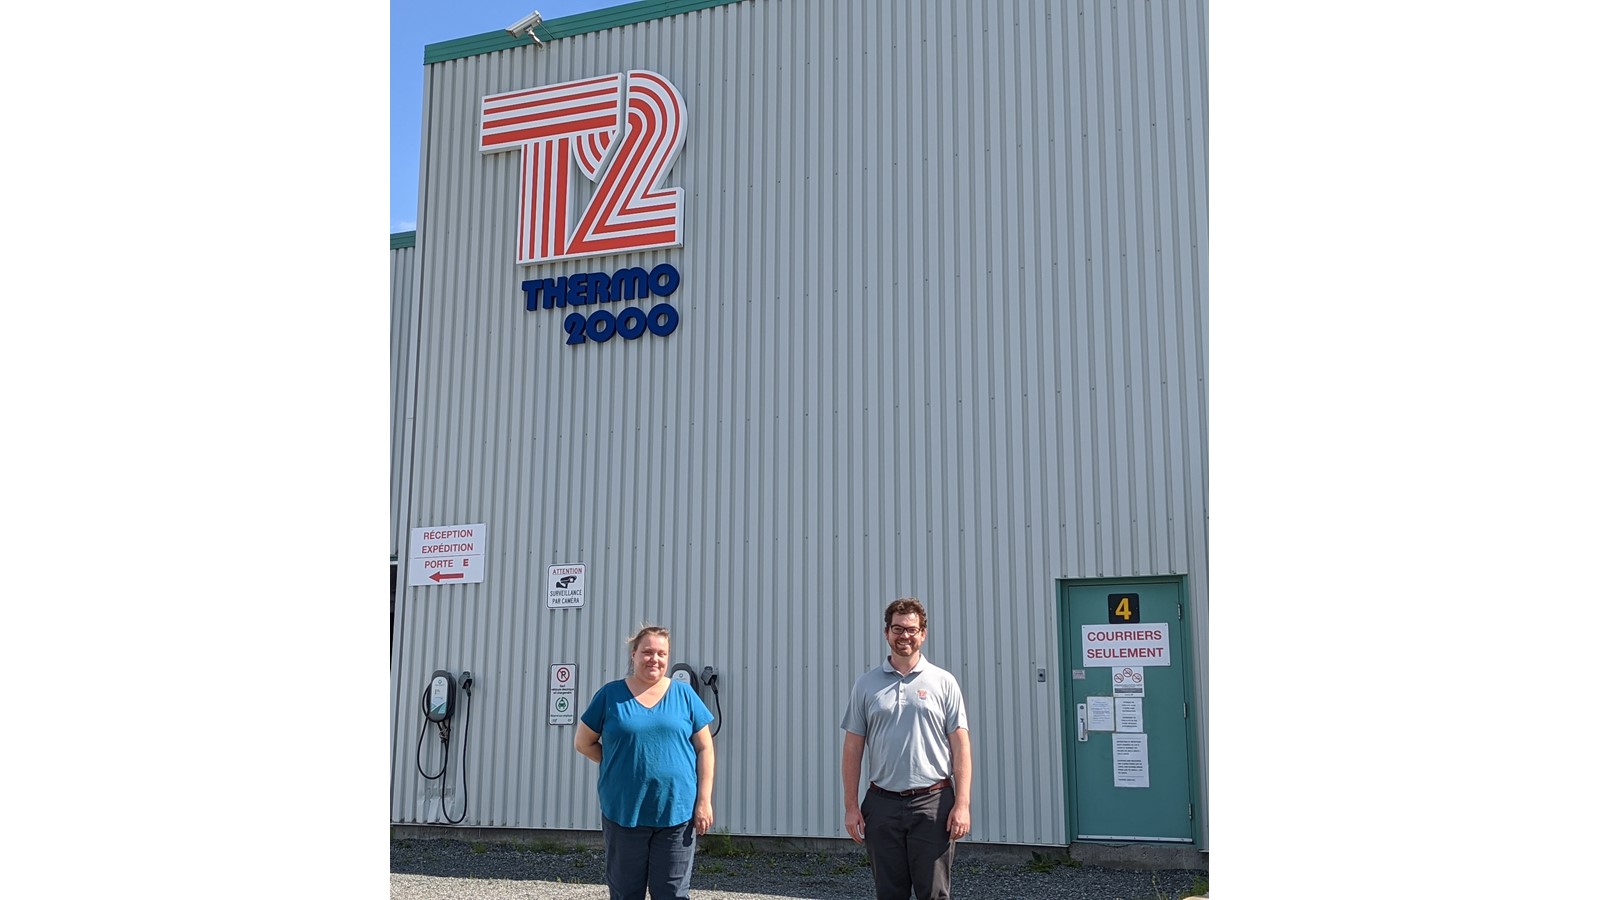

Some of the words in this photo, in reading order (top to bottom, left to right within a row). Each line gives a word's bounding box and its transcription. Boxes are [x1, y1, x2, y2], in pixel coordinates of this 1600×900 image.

[522, 263, 680, 311] THERMO
[564, 303, 680, 345] 2000
[423, 529, 473, 541] RÉCEPTION
[421, 543, 474, 554] EXPÉDITION
[424, 559, 454, 569] PORTE
[463, 558, 469, 567] E
[552, 567, 583, 575] ATTENTION
[550, 589, 582, 597] SURVEILLANCE
[561, 596, 580, 604] CAMÉRA
[1115, 597, 1132, 621] 4
[1087, 630, 1162, 642] COURRIERS
[1087, 647, 1164, 659] SEULEMENT
